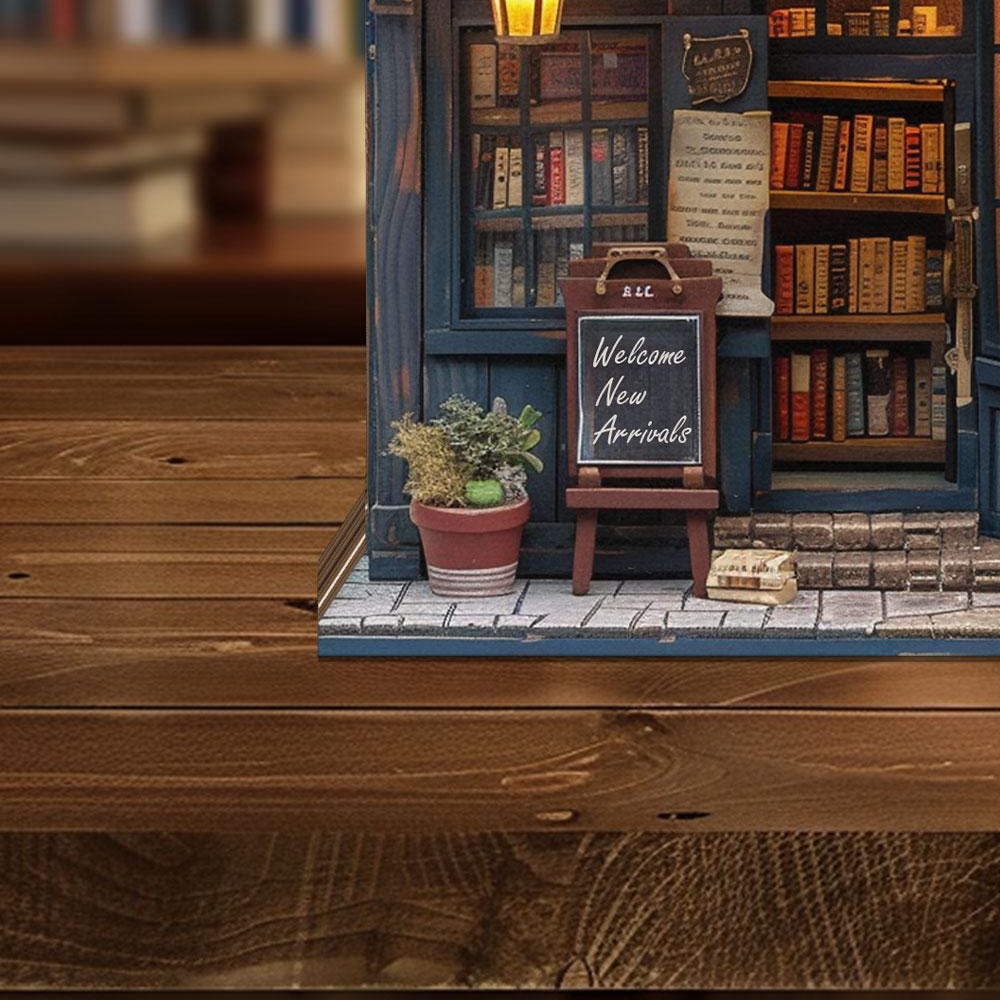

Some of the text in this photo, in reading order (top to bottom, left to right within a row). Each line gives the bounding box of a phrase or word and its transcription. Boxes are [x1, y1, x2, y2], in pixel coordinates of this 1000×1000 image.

[592, 334, 687, 368] Welcome
[594, 375, 648, 407] New
[592, 413, 693, 446] Arrivals
